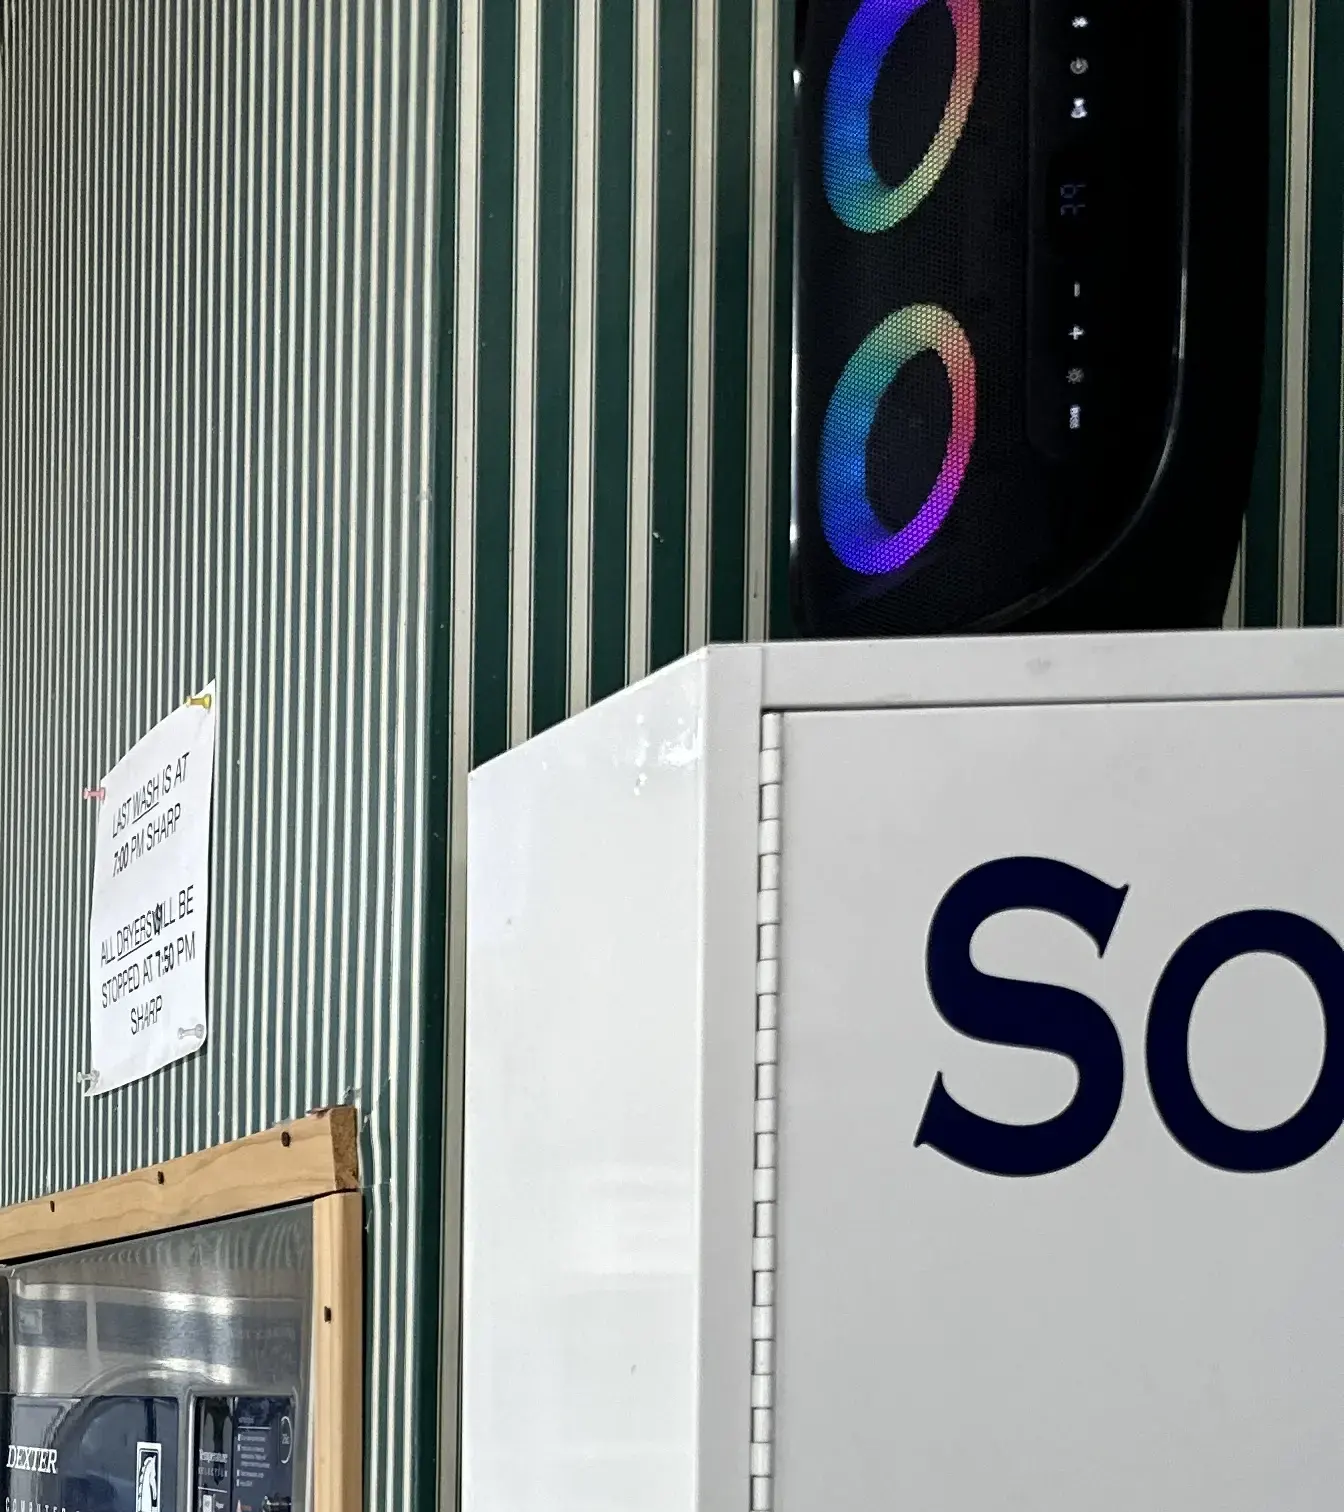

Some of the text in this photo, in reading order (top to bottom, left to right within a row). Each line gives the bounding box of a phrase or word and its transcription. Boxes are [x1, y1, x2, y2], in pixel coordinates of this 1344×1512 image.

[112, 751, 190, 838] LAST WASH IS AT
[113, 803, 181, 877] 7:00 PM SHARP
[101, 936, 115, 968] ALL
[116, 910, 152, 958] DRYERS
[179, 884, 194, 919] BE
[102, 931, 195, 1008] STOPPED AT 7:50 PM
[131, 995, 162, 1035] SHARP
[913, 856, 1344, 1177] SO
[6, 1445, 58, 1474] DEXTER
